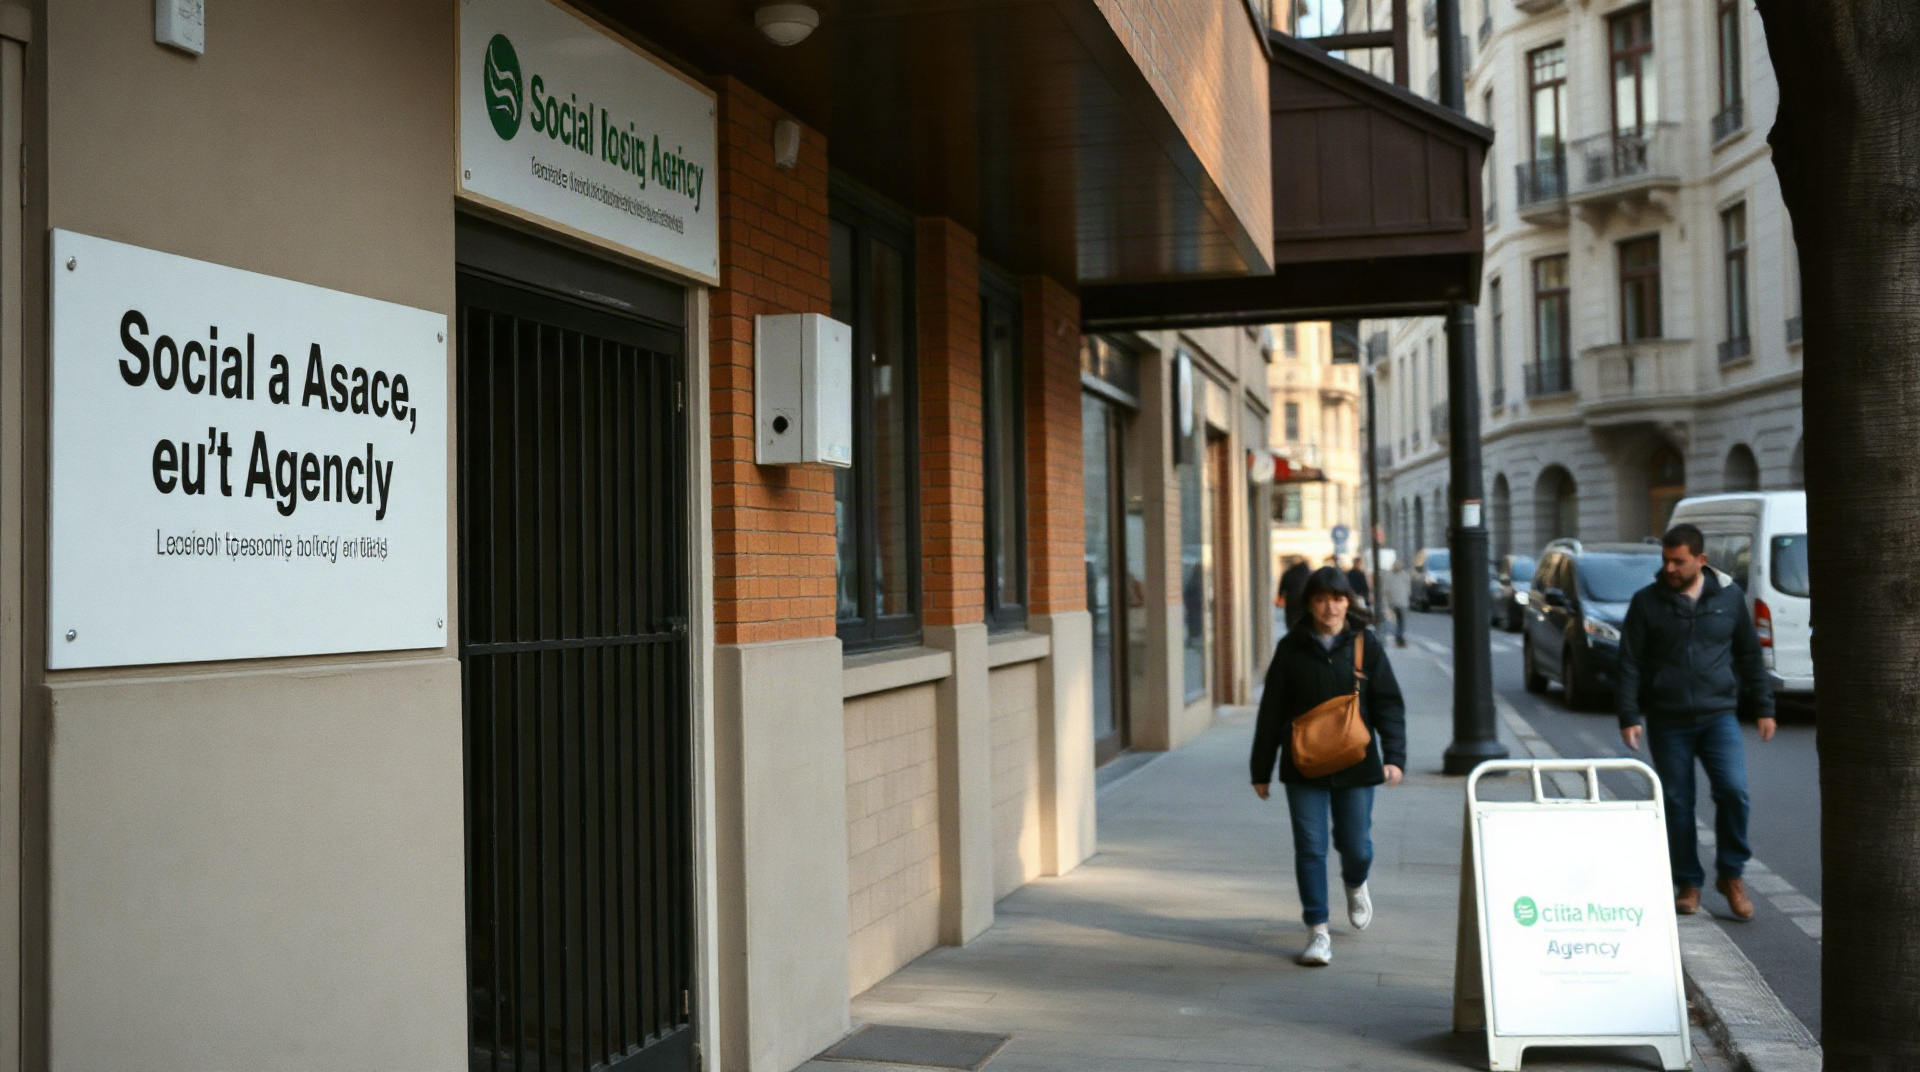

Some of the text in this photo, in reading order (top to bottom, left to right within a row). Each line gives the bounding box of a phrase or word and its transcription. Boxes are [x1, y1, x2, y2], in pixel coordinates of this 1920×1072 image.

[530, 73, 594, 157] Social
[118, 309, 417, 434] Social a Asace,
[244, 430, 394, 521] Agencly
